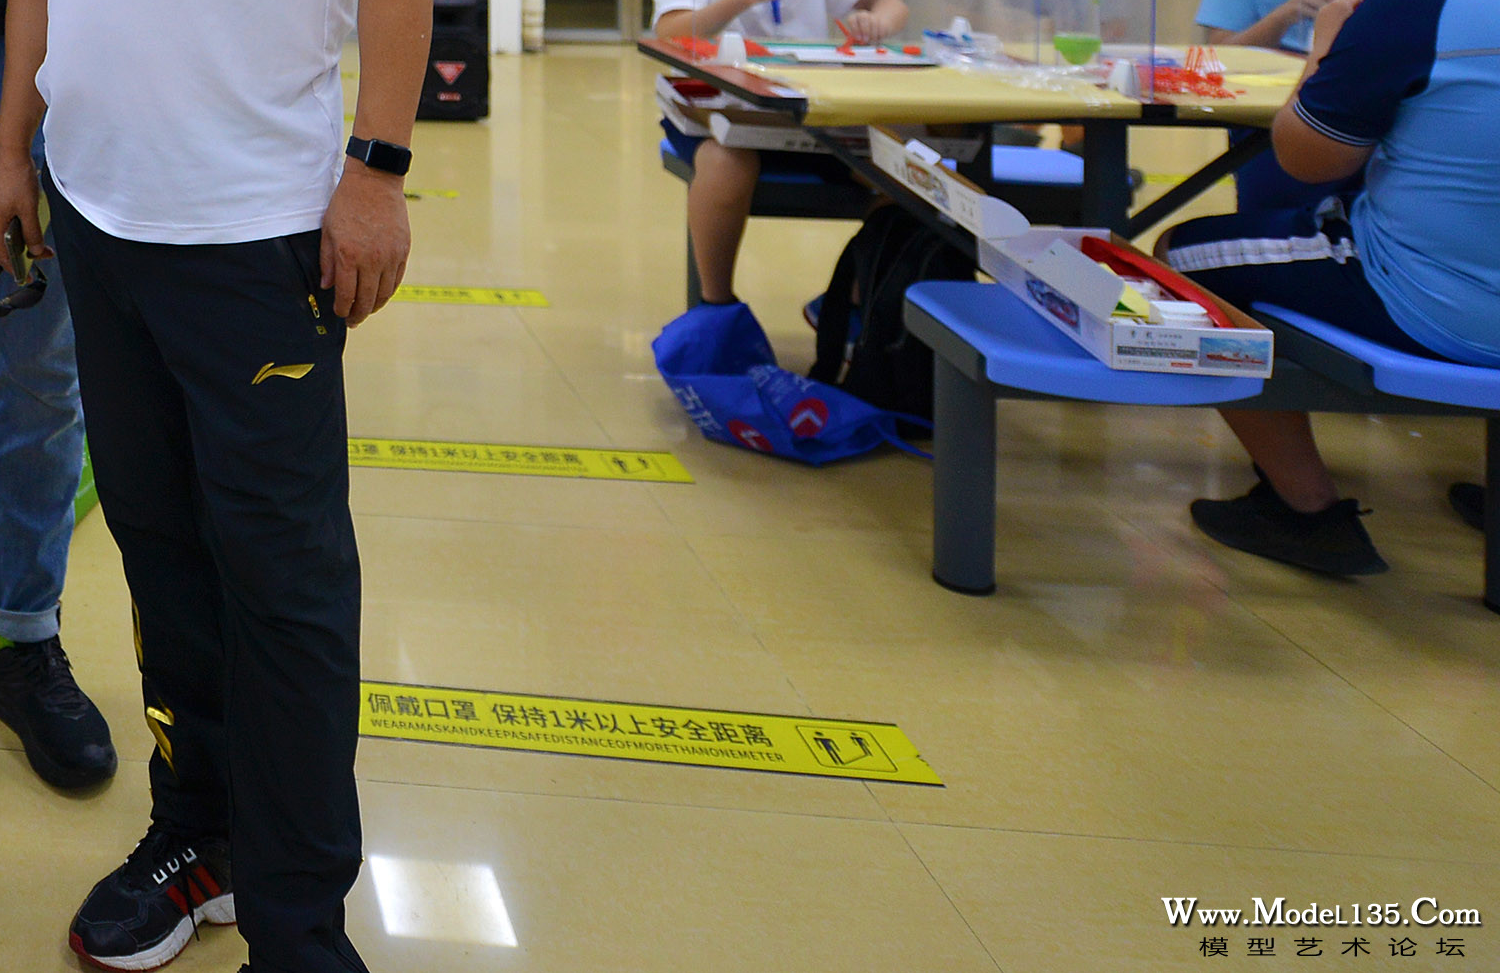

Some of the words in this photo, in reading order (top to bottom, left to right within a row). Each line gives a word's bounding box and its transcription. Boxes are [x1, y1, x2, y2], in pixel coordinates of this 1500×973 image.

[368, 693, 480, 721] 佩戴口罩
[492, 703, 773, 747] 保持1米以上安全距离
[371, 718, 786, 763] WEARAMASKANDKEEPASAFEDISTANCEOFMORETHANONEMETER
